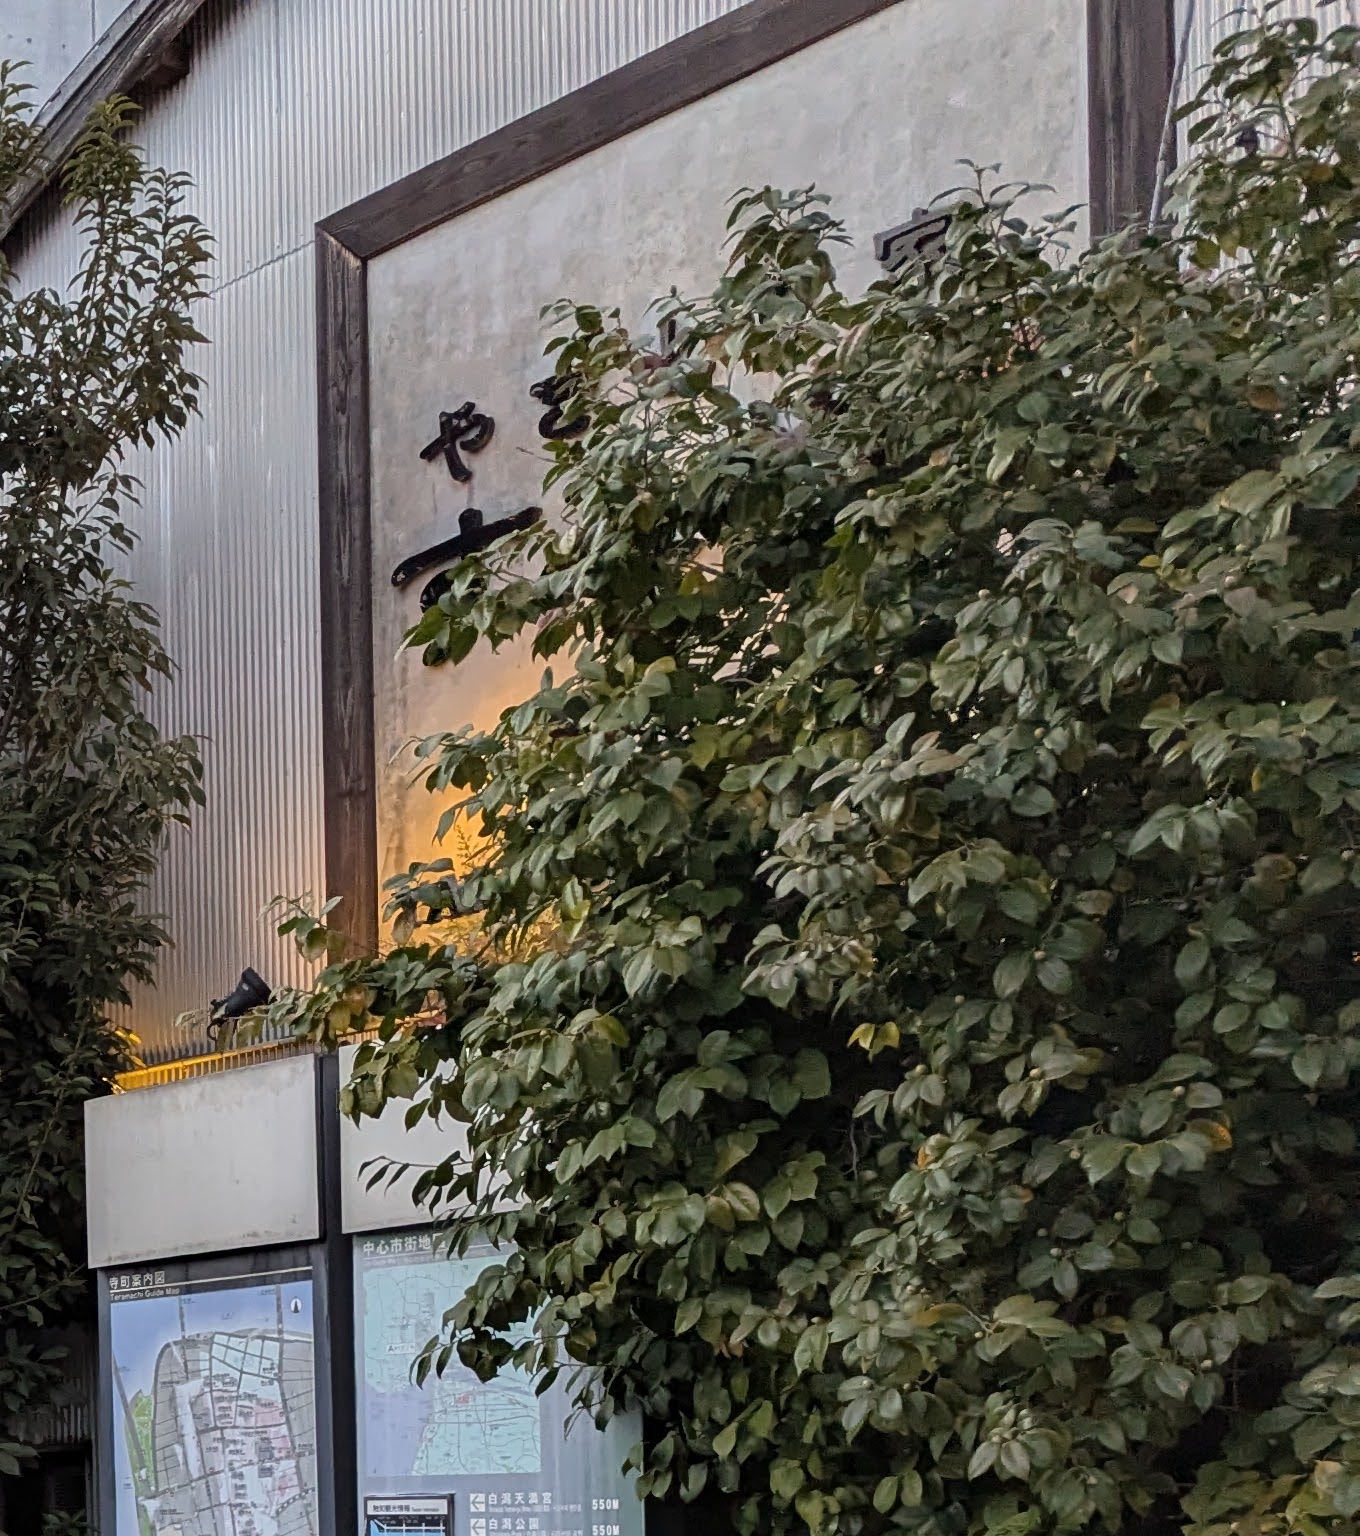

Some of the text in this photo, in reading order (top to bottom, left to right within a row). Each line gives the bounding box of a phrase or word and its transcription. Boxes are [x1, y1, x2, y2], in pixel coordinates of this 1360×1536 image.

[109, 1270, 165, 1289] 寺町案内図
[145, 1289, 165, 1298] Guide
[166, 1287, 180, 1297] Map
[592, 1499, 619, 1510] 550M
[489, 1517, 539, 1530] 白潟公園
[592, 1525, 620, 1536] 550M
